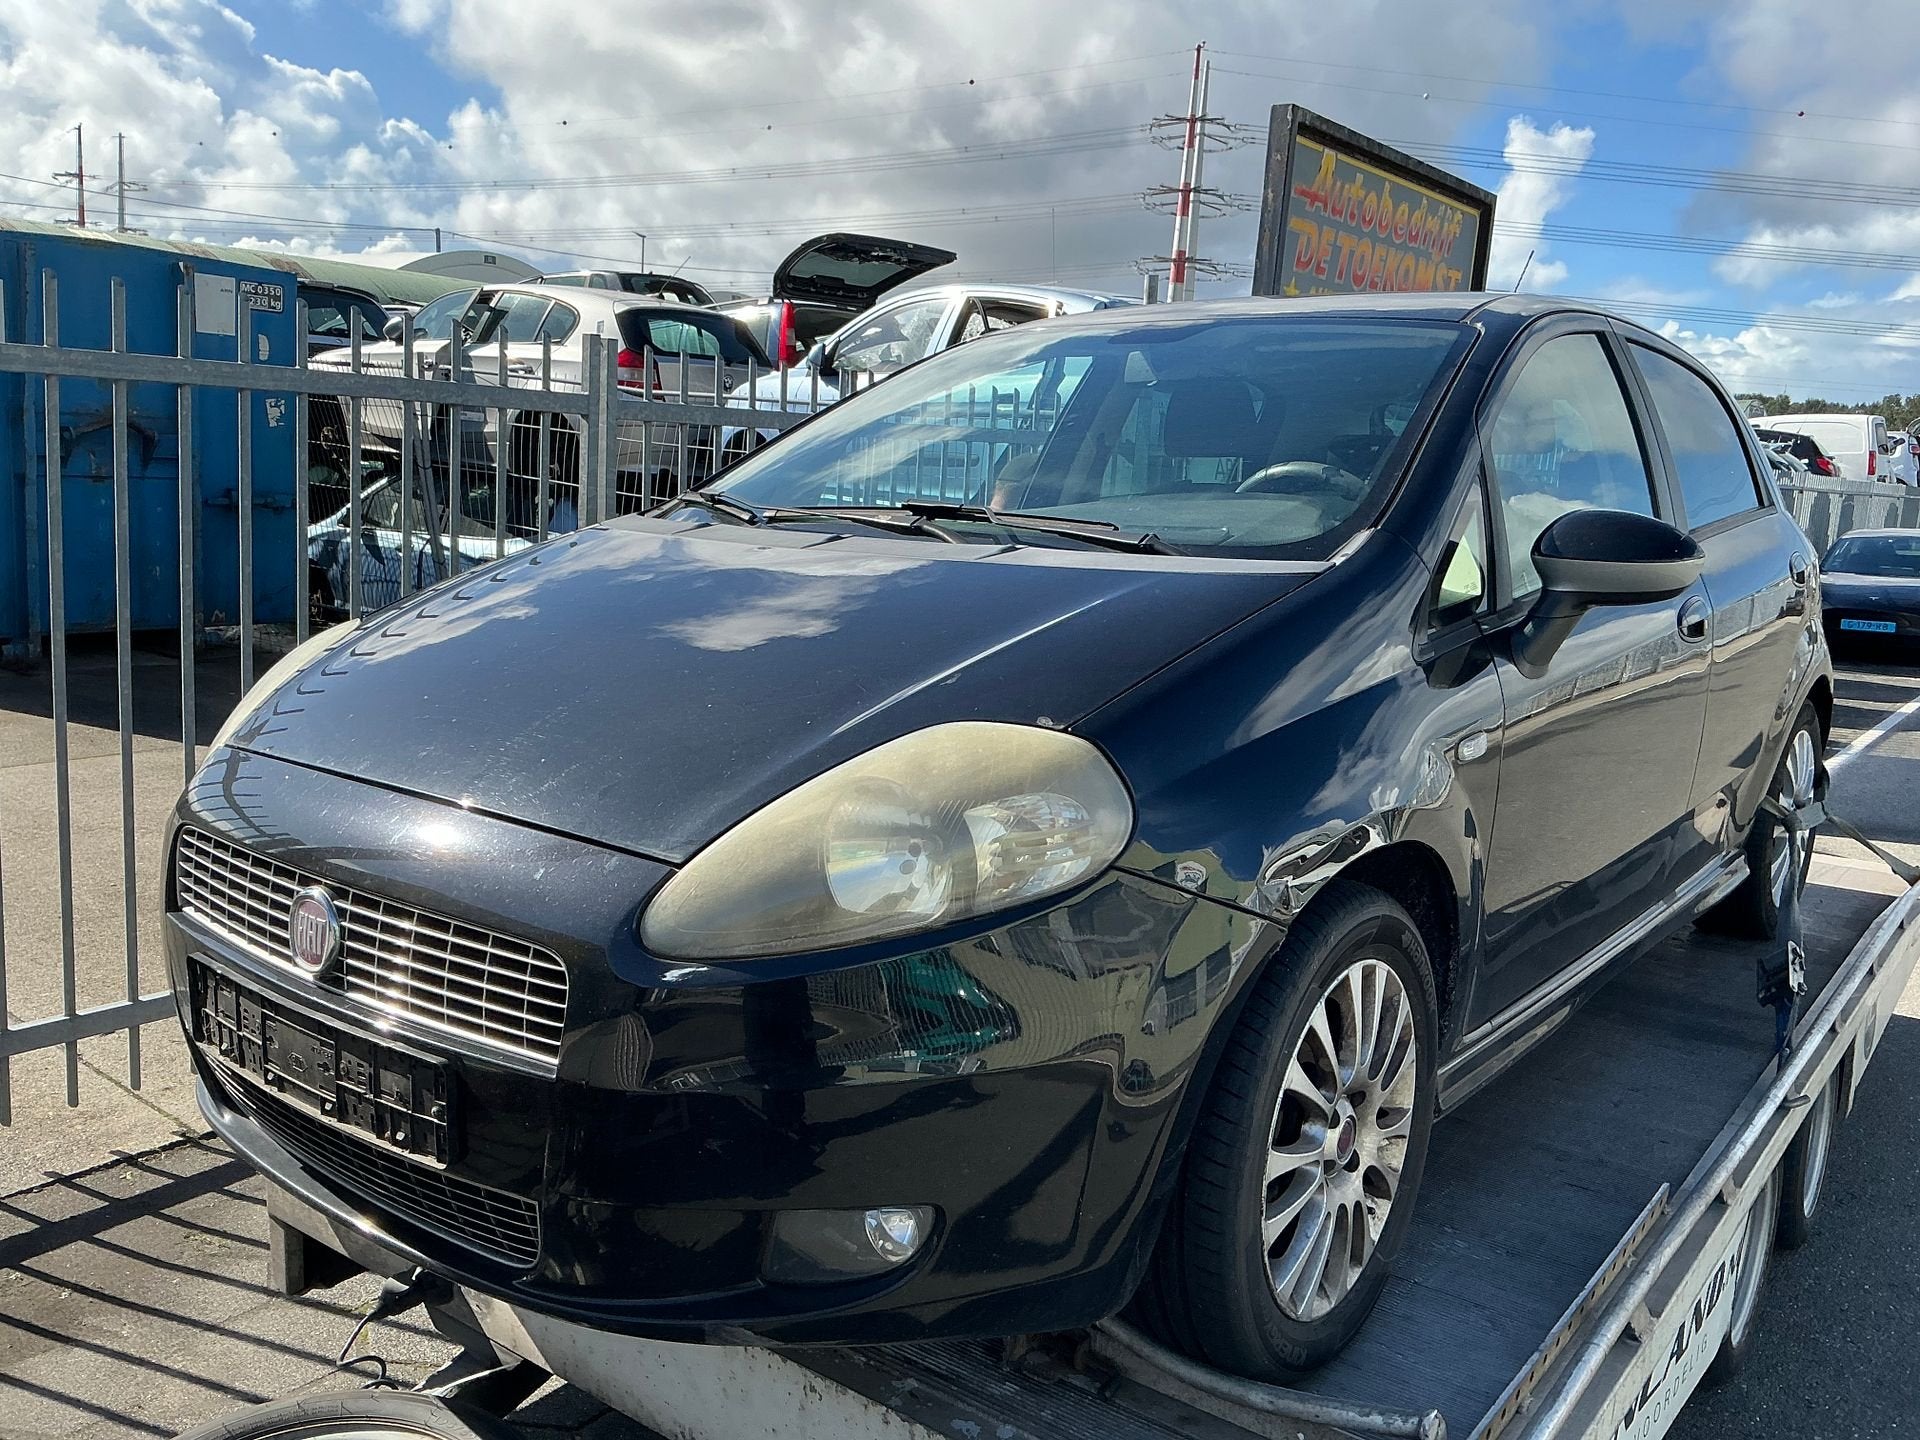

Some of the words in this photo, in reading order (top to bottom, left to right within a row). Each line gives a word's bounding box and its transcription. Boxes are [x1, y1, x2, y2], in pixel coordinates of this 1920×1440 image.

[1292, 147, 1463, 258] Autobedrijf
[1288, 216, 1337, 281] DE
[1334, 229, 1463, 292] TOEKOMST
[257, 285, 281, 296] 0350
[270, 298, 281, 310] kg
[298, 909, 328, 957] FIAT
